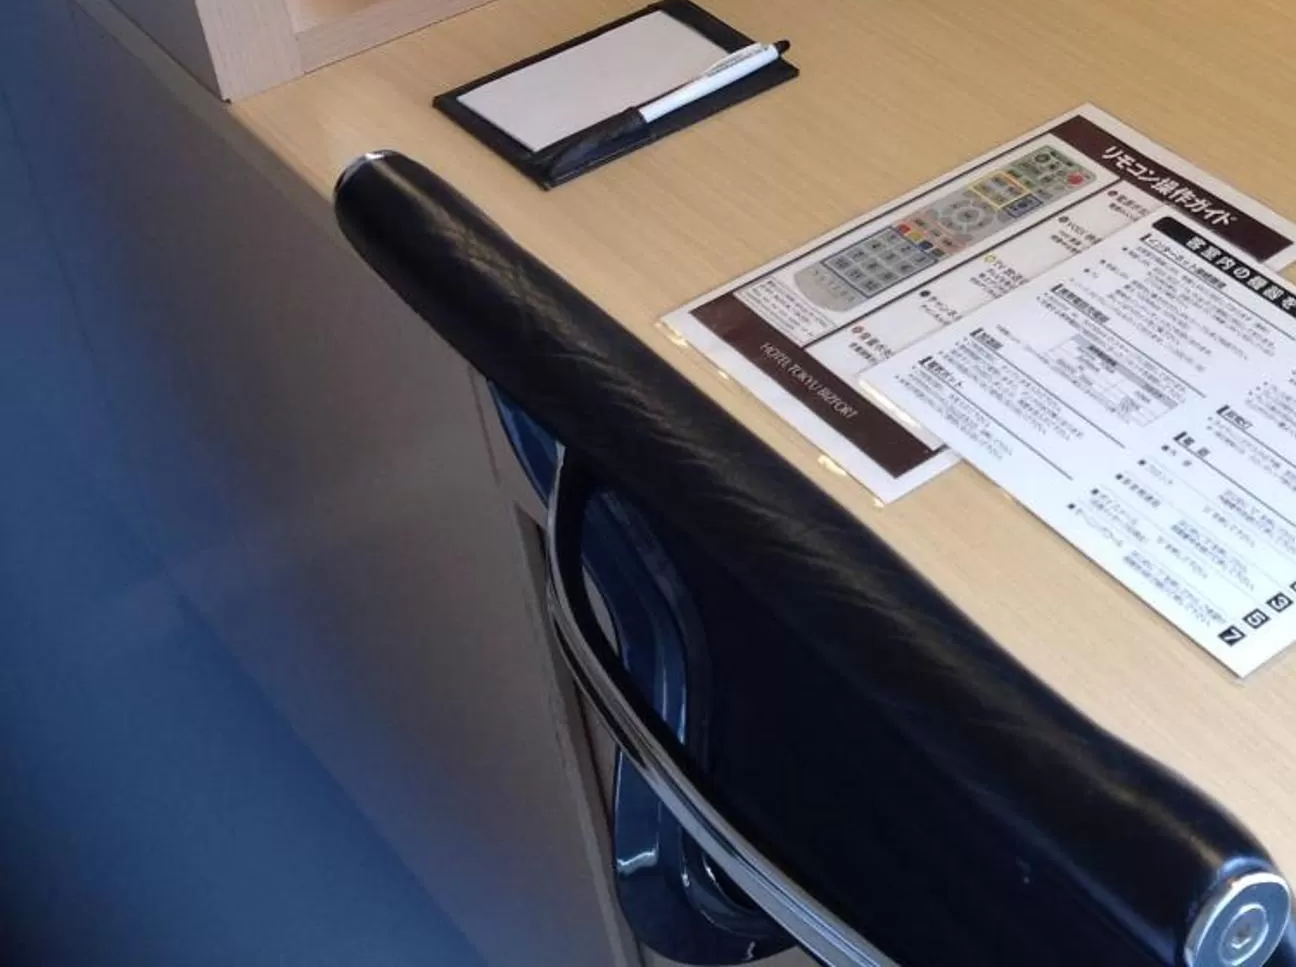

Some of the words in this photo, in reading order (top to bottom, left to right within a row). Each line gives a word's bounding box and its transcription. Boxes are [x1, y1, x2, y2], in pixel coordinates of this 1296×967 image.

[1095, 144, 1240, 230] リモコン操作ガイド
[760, 342, 792, 368] HOTEL
[787, 364, 821, 391] TOKYU
[1267, 594, 1291, 611] 3
[1244, 611, 1268, 627] 5
[1219, 628, 1243, 644] 7
